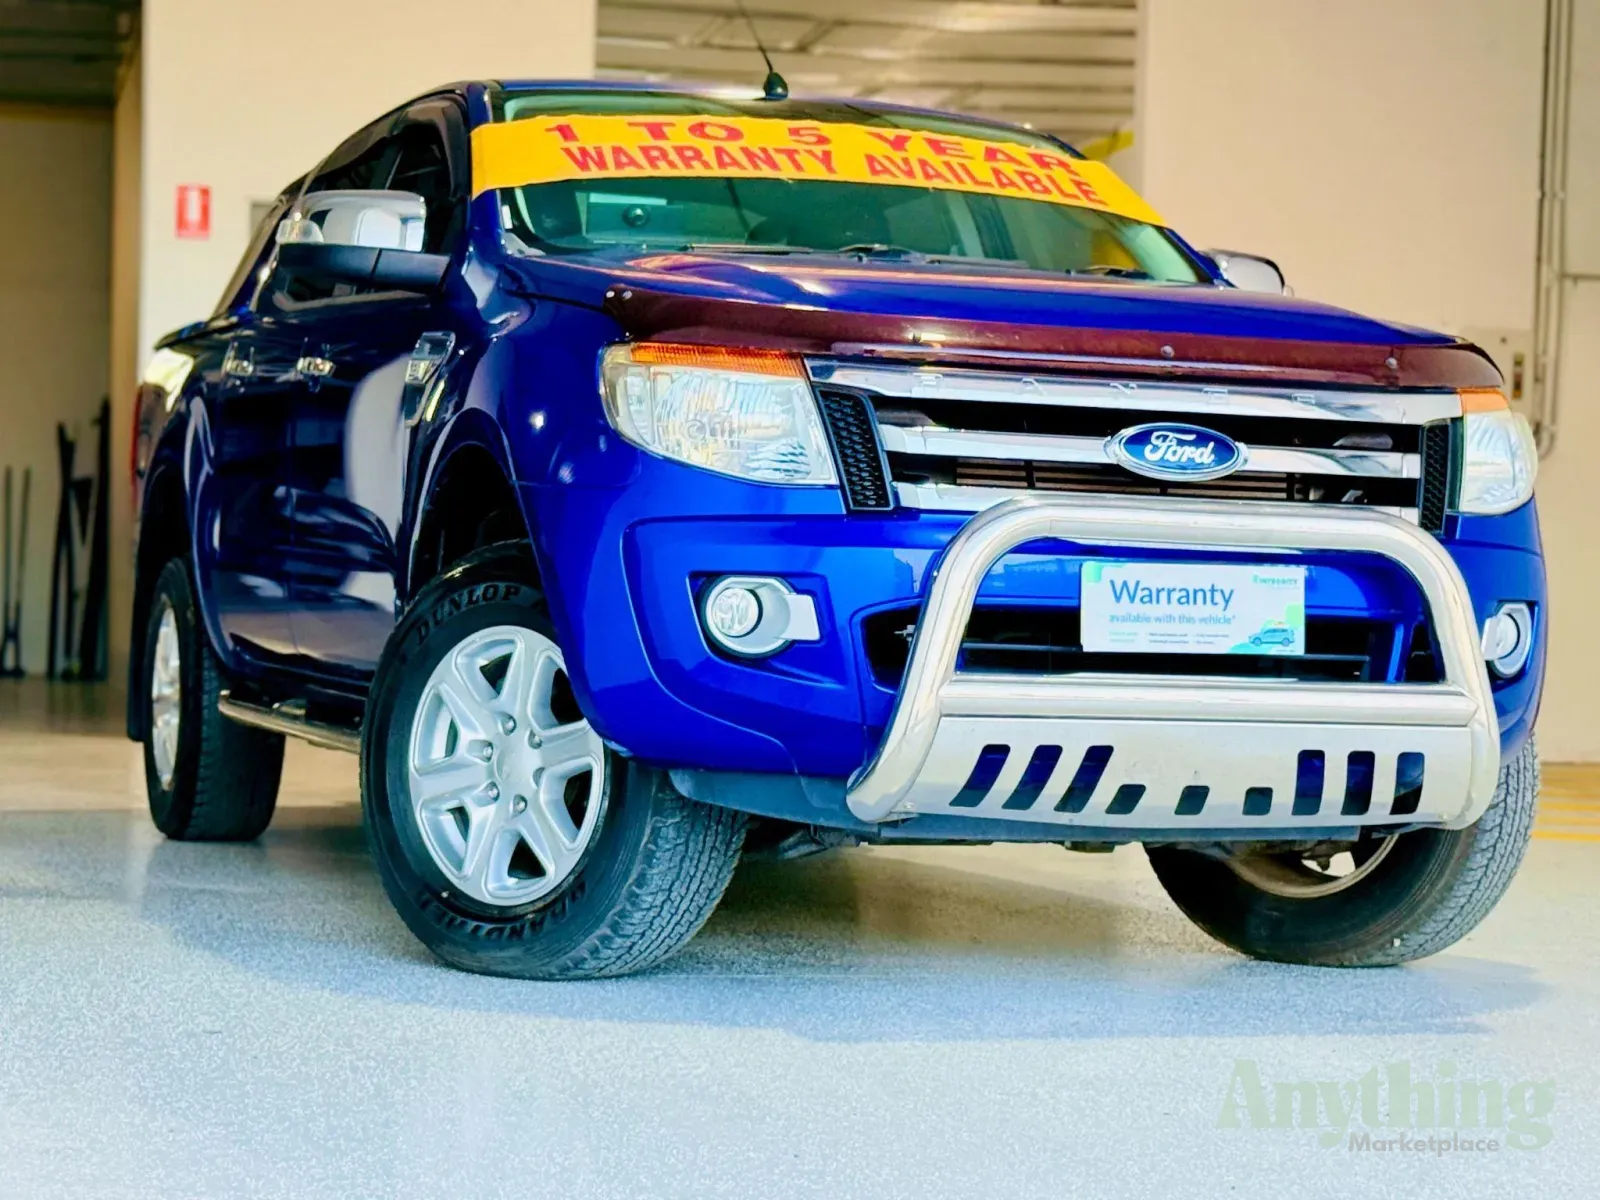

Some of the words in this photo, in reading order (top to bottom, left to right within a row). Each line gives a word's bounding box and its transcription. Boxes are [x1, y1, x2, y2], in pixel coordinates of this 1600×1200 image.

[545, 124, 579, 142] 1
[626, 121, 745, 142] TO
[788, 126, 833, 146] 5
[866, 132, 1082, 177] YEAR
[560, 145, 838, 174] WARRANTY
[864, 153, 1109, 206] AVAILABLE
[1144, 430, 1216, 464] Ford
[416, 584, 521, 645] DUNLOP
[1109, 579, 1234, 612] Warranty
[1109, 613, 1151, 623] available
[1154, 613, 1176, 623] with
[1178, 613, 1196, 624] this
